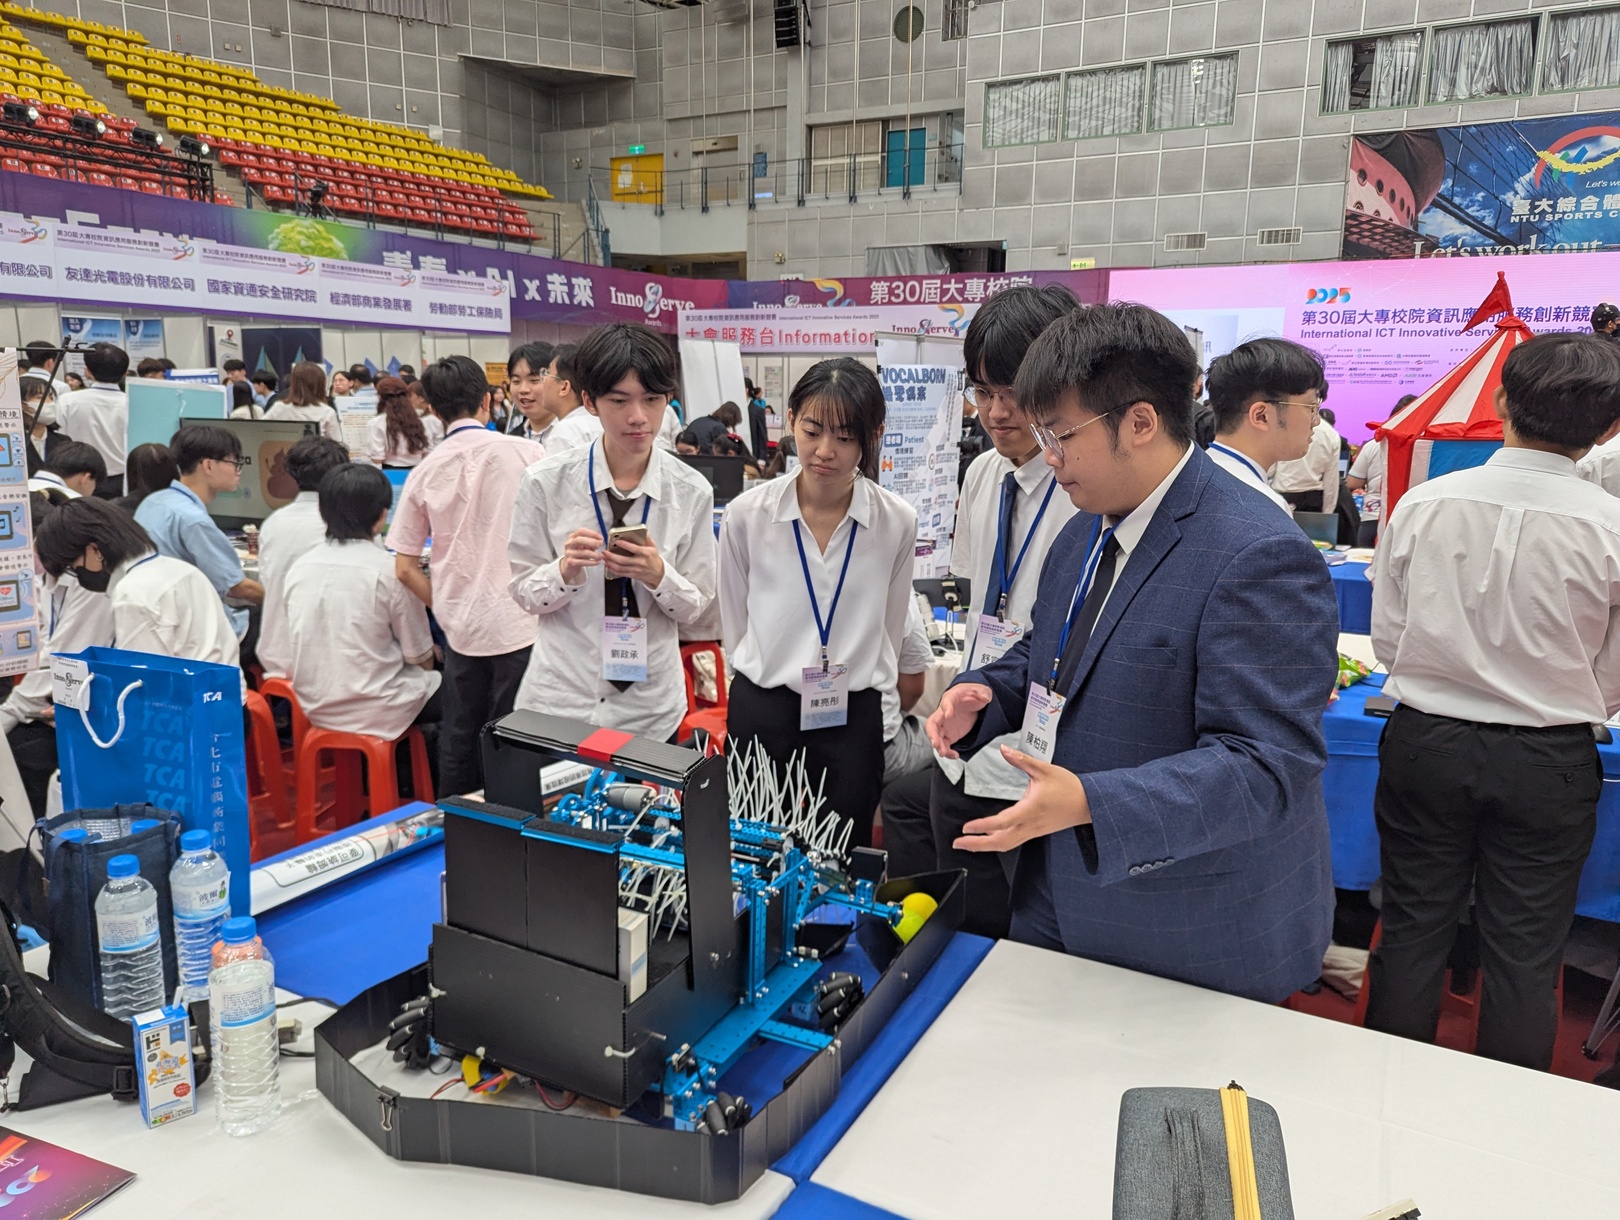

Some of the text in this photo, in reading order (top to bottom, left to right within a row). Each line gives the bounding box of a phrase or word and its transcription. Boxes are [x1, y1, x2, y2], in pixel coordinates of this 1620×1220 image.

[1511, 215, 1539, 223] NTU
[1545, 211, 1602, 220] SPORTS
[1414, 234, 1603, 258] Let's work out
[0, 262, 53, 279] 有限公司
[65, 266, 196, 292] 友達光電股份有限公司
[207, 278, 317, 304] 國家資通安全研究院
[1305, 287, 1352, 304] 2025
[330, 291, 412, 313] 經濟部商業發展署
[429, 302, 503, 321] 勞動部勞工保險局
[1301, 329, 1372, 339] International
[1376, 328, 1395, 337] ICT
[1399, 327, 1462, 337] Innovative
[882, 367, 946, 384] VOCALBORN
